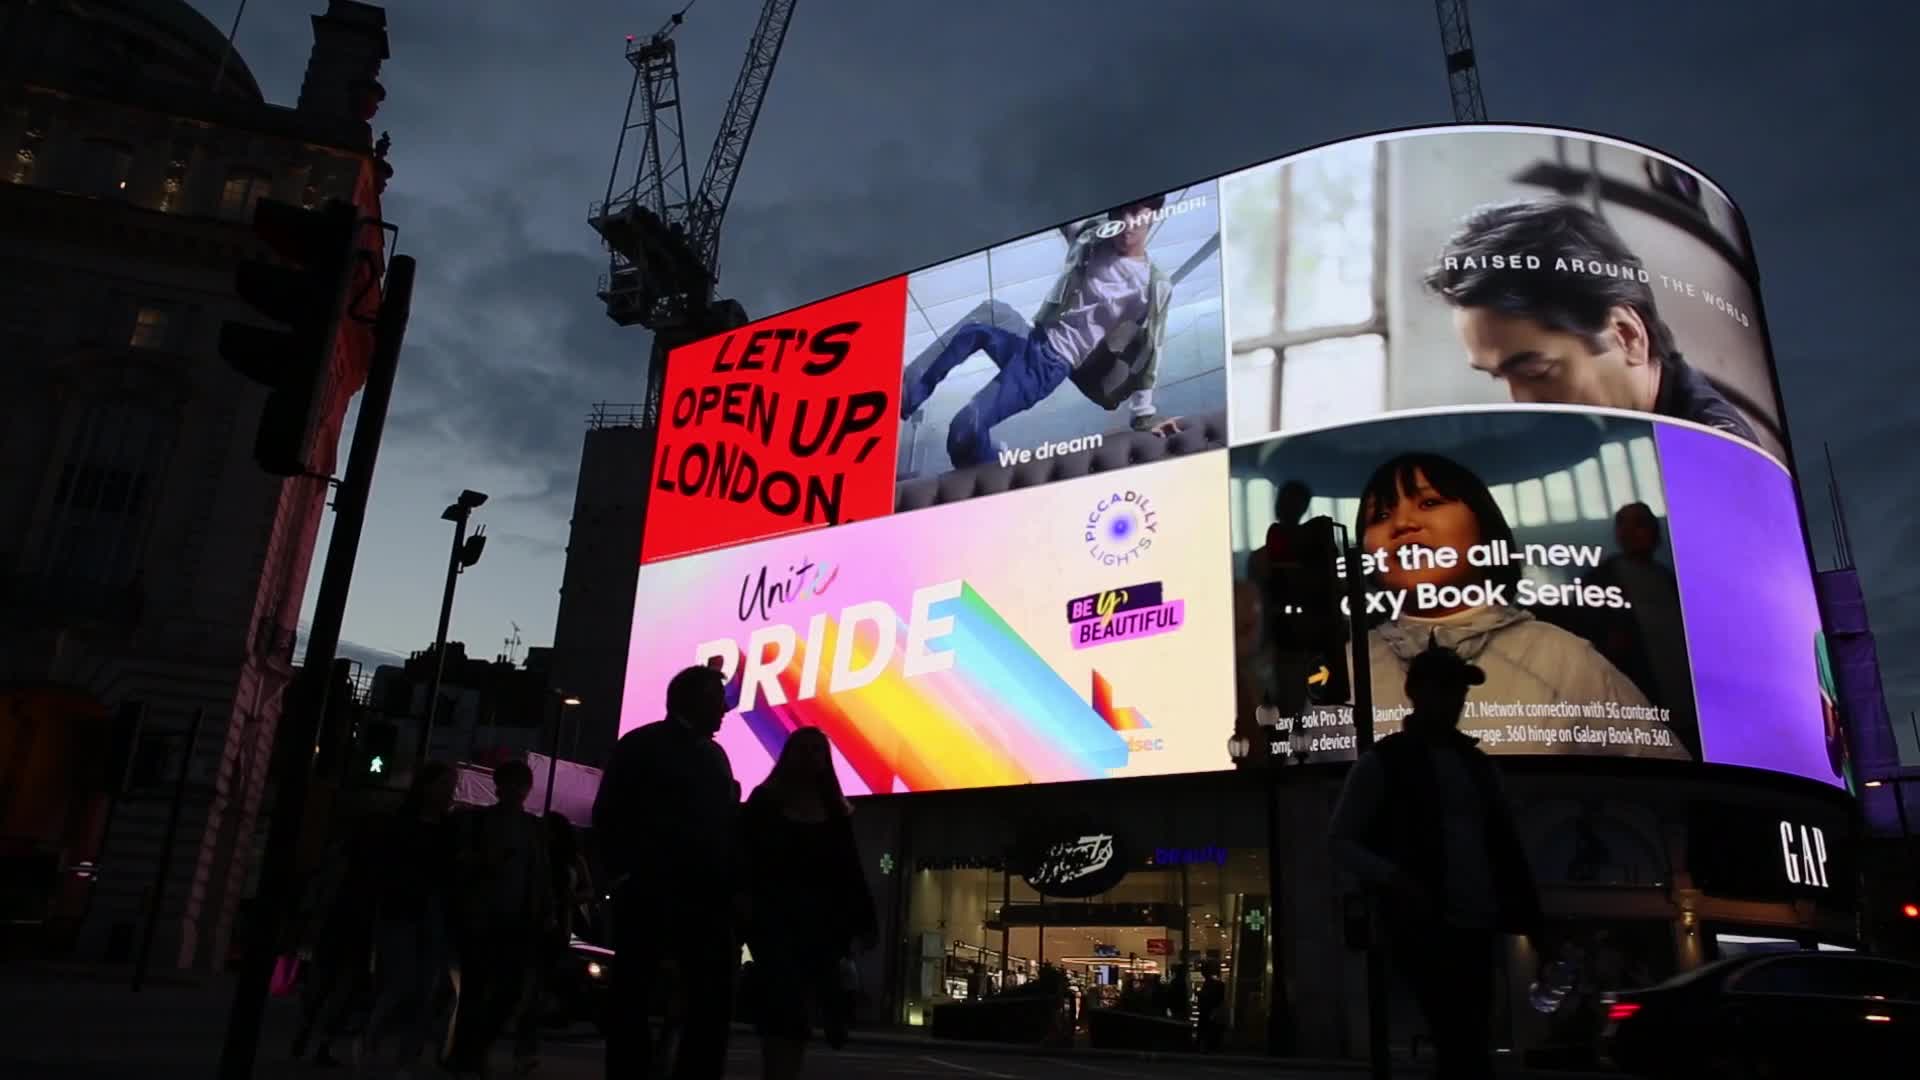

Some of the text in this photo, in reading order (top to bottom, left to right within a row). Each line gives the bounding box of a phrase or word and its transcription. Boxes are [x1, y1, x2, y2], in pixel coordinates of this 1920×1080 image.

[1444, 254, 1749, 328] RAISED AROUND THE WORLD
[712, 320, 863, 377] LET'S
[672, 382, 889, 464] OPEN UP,
[998, 433, 1103, 468] We dream
[1085, 490, 1158, 542] PICCADILLY
[1089, 537, 1152, 567] LIGHTS
[1397, 543, 1460, 570] the
[1467, 539, 1603, 568] all-new
[1072, 598, 1094, 620] BE
[1417, 579, 1509, 610] Book
[1516, 577, 1632, 609] Series.
[1080, 606, 1179, 644] BEAUTIFUL
[695, 579, 965, 713] PRIDE
[1301, 709, 1319, 729] ook
[1320, 709, 1337, 727] Pro
[1464, 700, 1480, 718] 21.
[1480, 700, 1525, 718] Network
[1525, 700, 1582, 719] connection
[1583, 702, 1606, 719] with
[1606, 703, 1620, 720] 5G
[1621, 704, 1659, 722] contract
[1660, 708, 1670, 722] or
[1320, 732, 1350, 751] device
[1506, 724, 1527, 742] 360
[1528, 724, 1558, 747] hinge
[1559, 729, 1573, 743] on
[1574, 725, 1607, 747] Galaxy
[1609, 726, 1633, 745] Book
[1635, 727, 1651, 745] Pro
[1652, 728, 1673, 747] 360.
[1780, 820, 1829, 888] GAP
